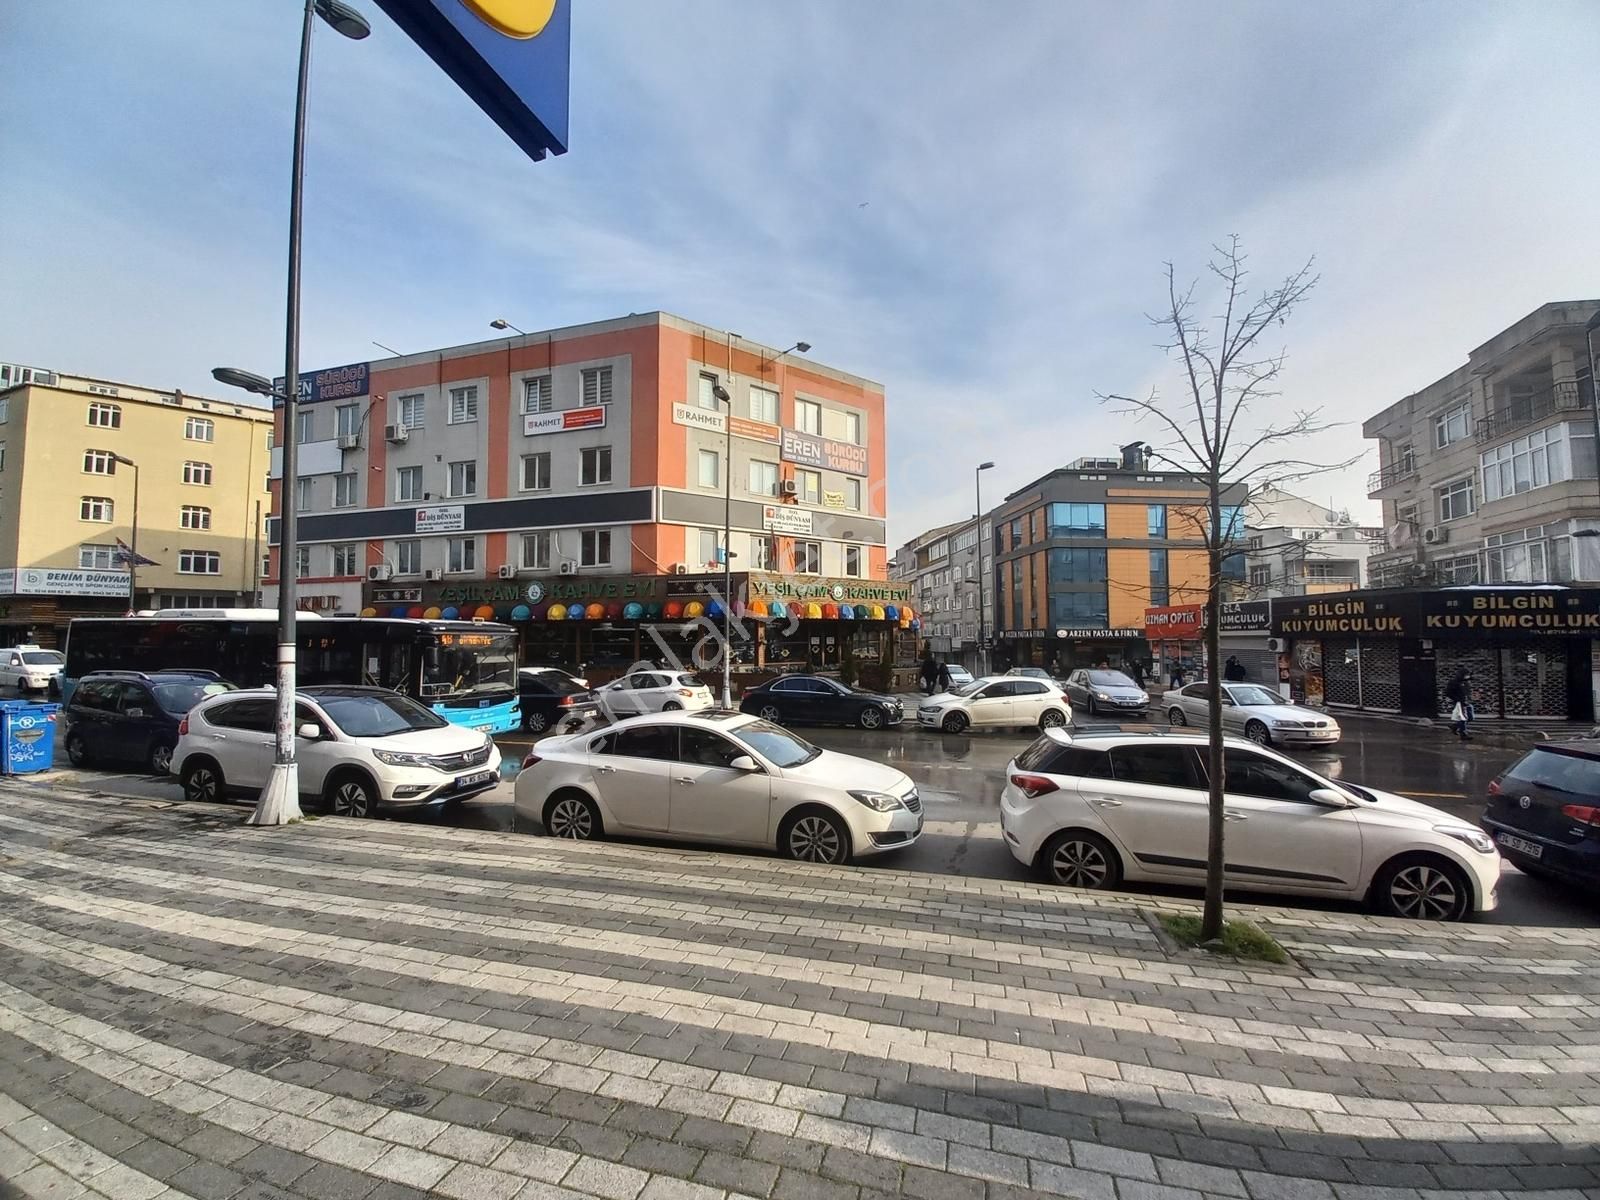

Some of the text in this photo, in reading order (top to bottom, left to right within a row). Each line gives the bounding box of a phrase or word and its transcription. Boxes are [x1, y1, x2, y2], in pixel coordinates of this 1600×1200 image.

[275, 381, 312, 399] EN
[320, 380, 361, 399] KURSU
[534, 418, 561, 428] RAHMET
[685, 410, 723, 427] RAHMET
[784, 438, 821, 458] EREN
[437, 512, 462, 521] DÜNYASI
[786, 513, 811, 524] DÜNYASI
[47, 570, 130, 584] BENİM DÜNYAM
[439, 585, 520, 604] YEŞİLÇAM
[552, 582, 618, 599] KAHVE
[753, 581, 827, 600] YEŞİLÇAM
[847, 588, 891, 600] KAHVE
[1308, 597, 1365, 616] BİLGİN
[1472, 593, 1554, 610] BİLGİN
[1145, 613, 1169, 625] UZMAN
[1282, 617, 1402, 632] KUYUMCULUK
[1426, 613, 1600, 628] KUYUMCULUK
[1093, 630, 1114, 638] PASTA
[1114, 630, 1120, 638] &
